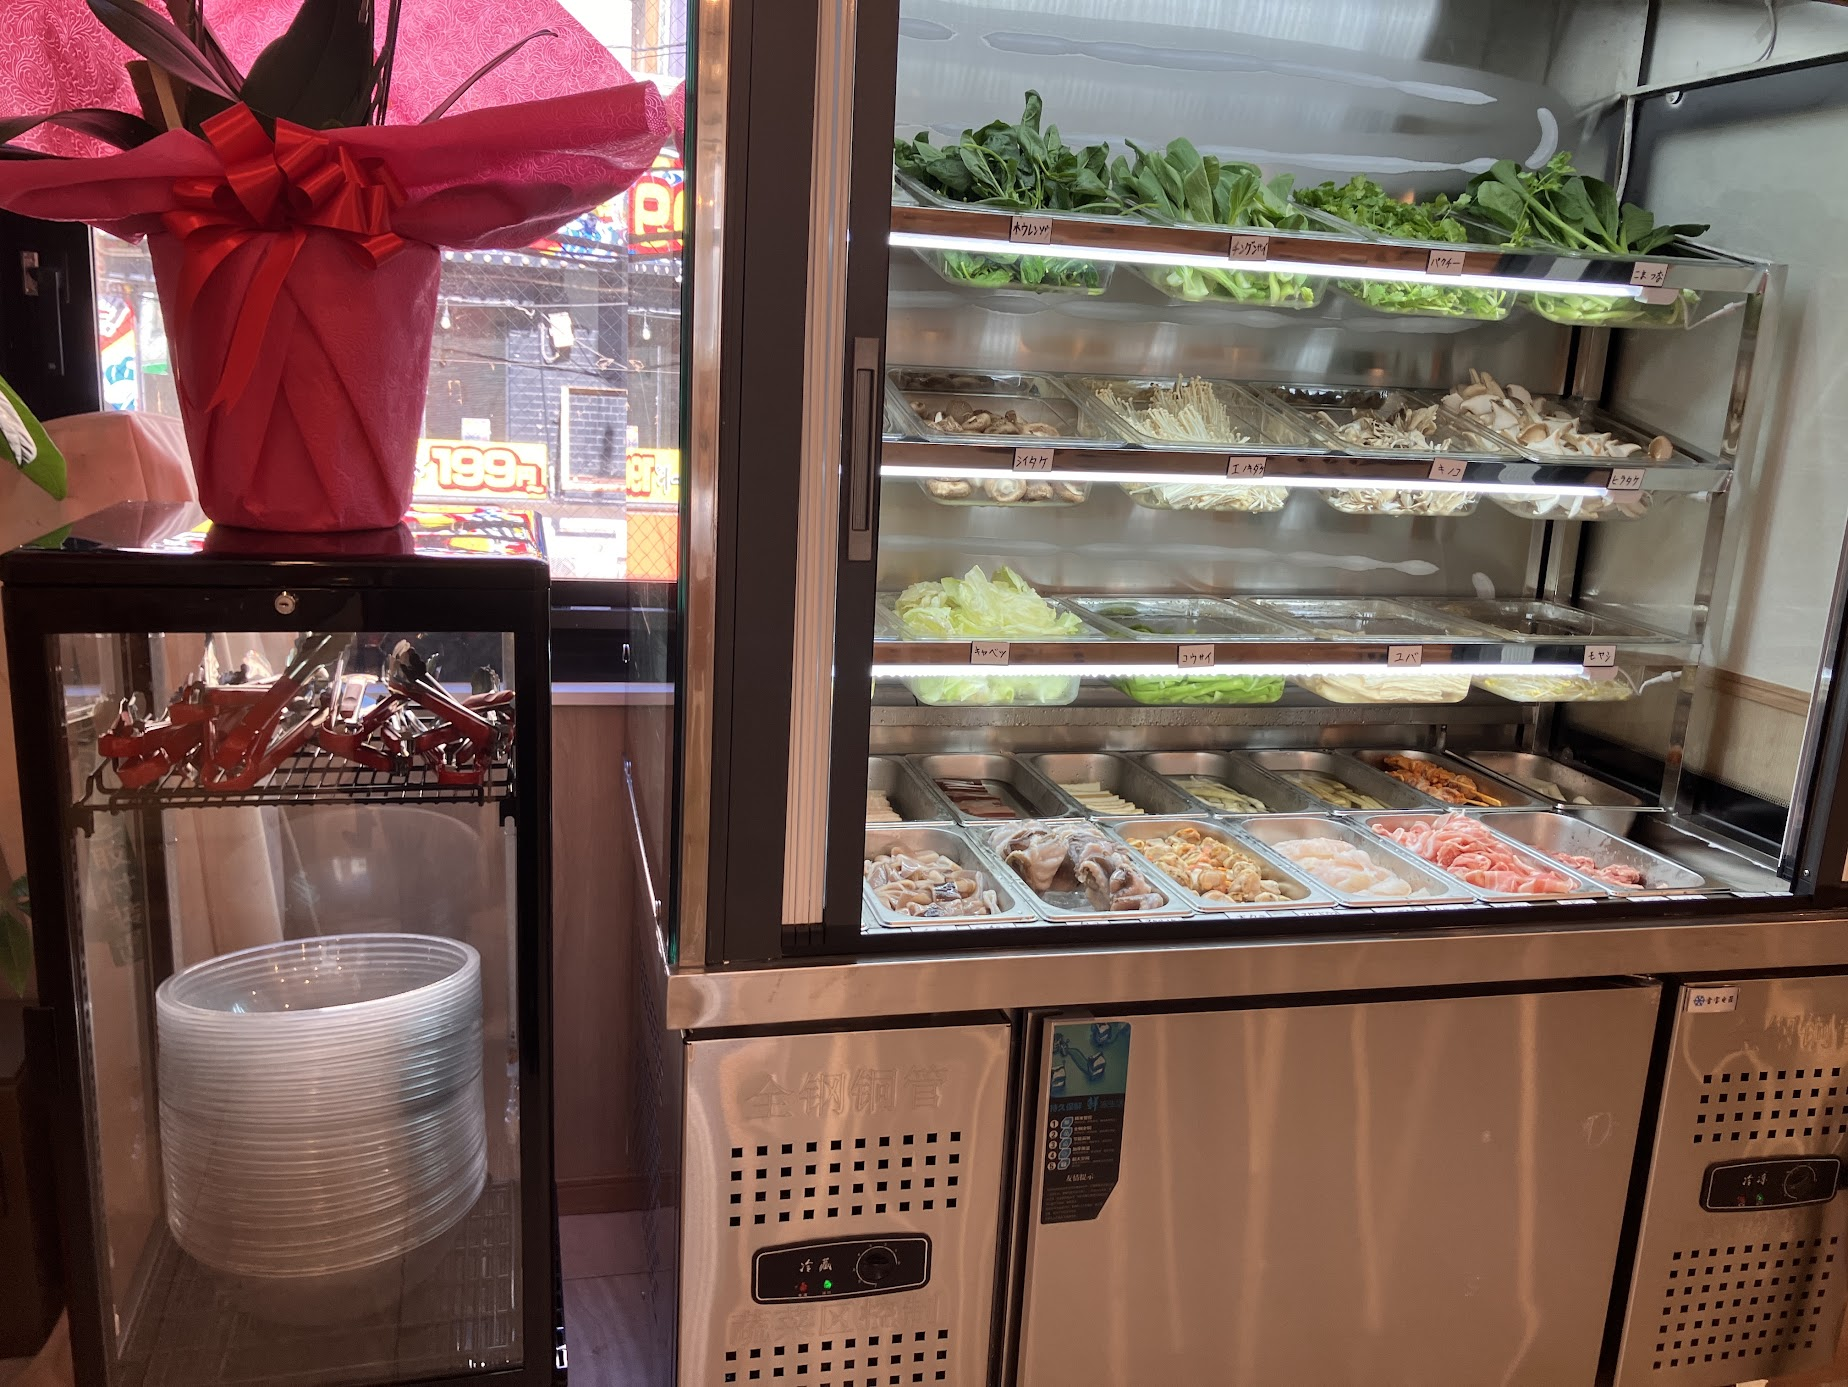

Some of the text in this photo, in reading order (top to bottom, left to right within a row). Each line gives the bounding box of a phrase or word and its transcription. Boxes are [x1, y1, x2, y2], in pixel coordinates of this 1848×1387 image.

[1430, 257, 1460, 269] パクチー
[1015, 455, 1049, 469] シイタケ
[1437, 463, 1461, 477] キノコ
[1611, 475, 1640, 486] ヒラタケ
[974, 646, 1007, 658] キャベツ
[1182, 652, 1212, 664] コウサイ
[1588, 651, 1611, 663] モヤシ
